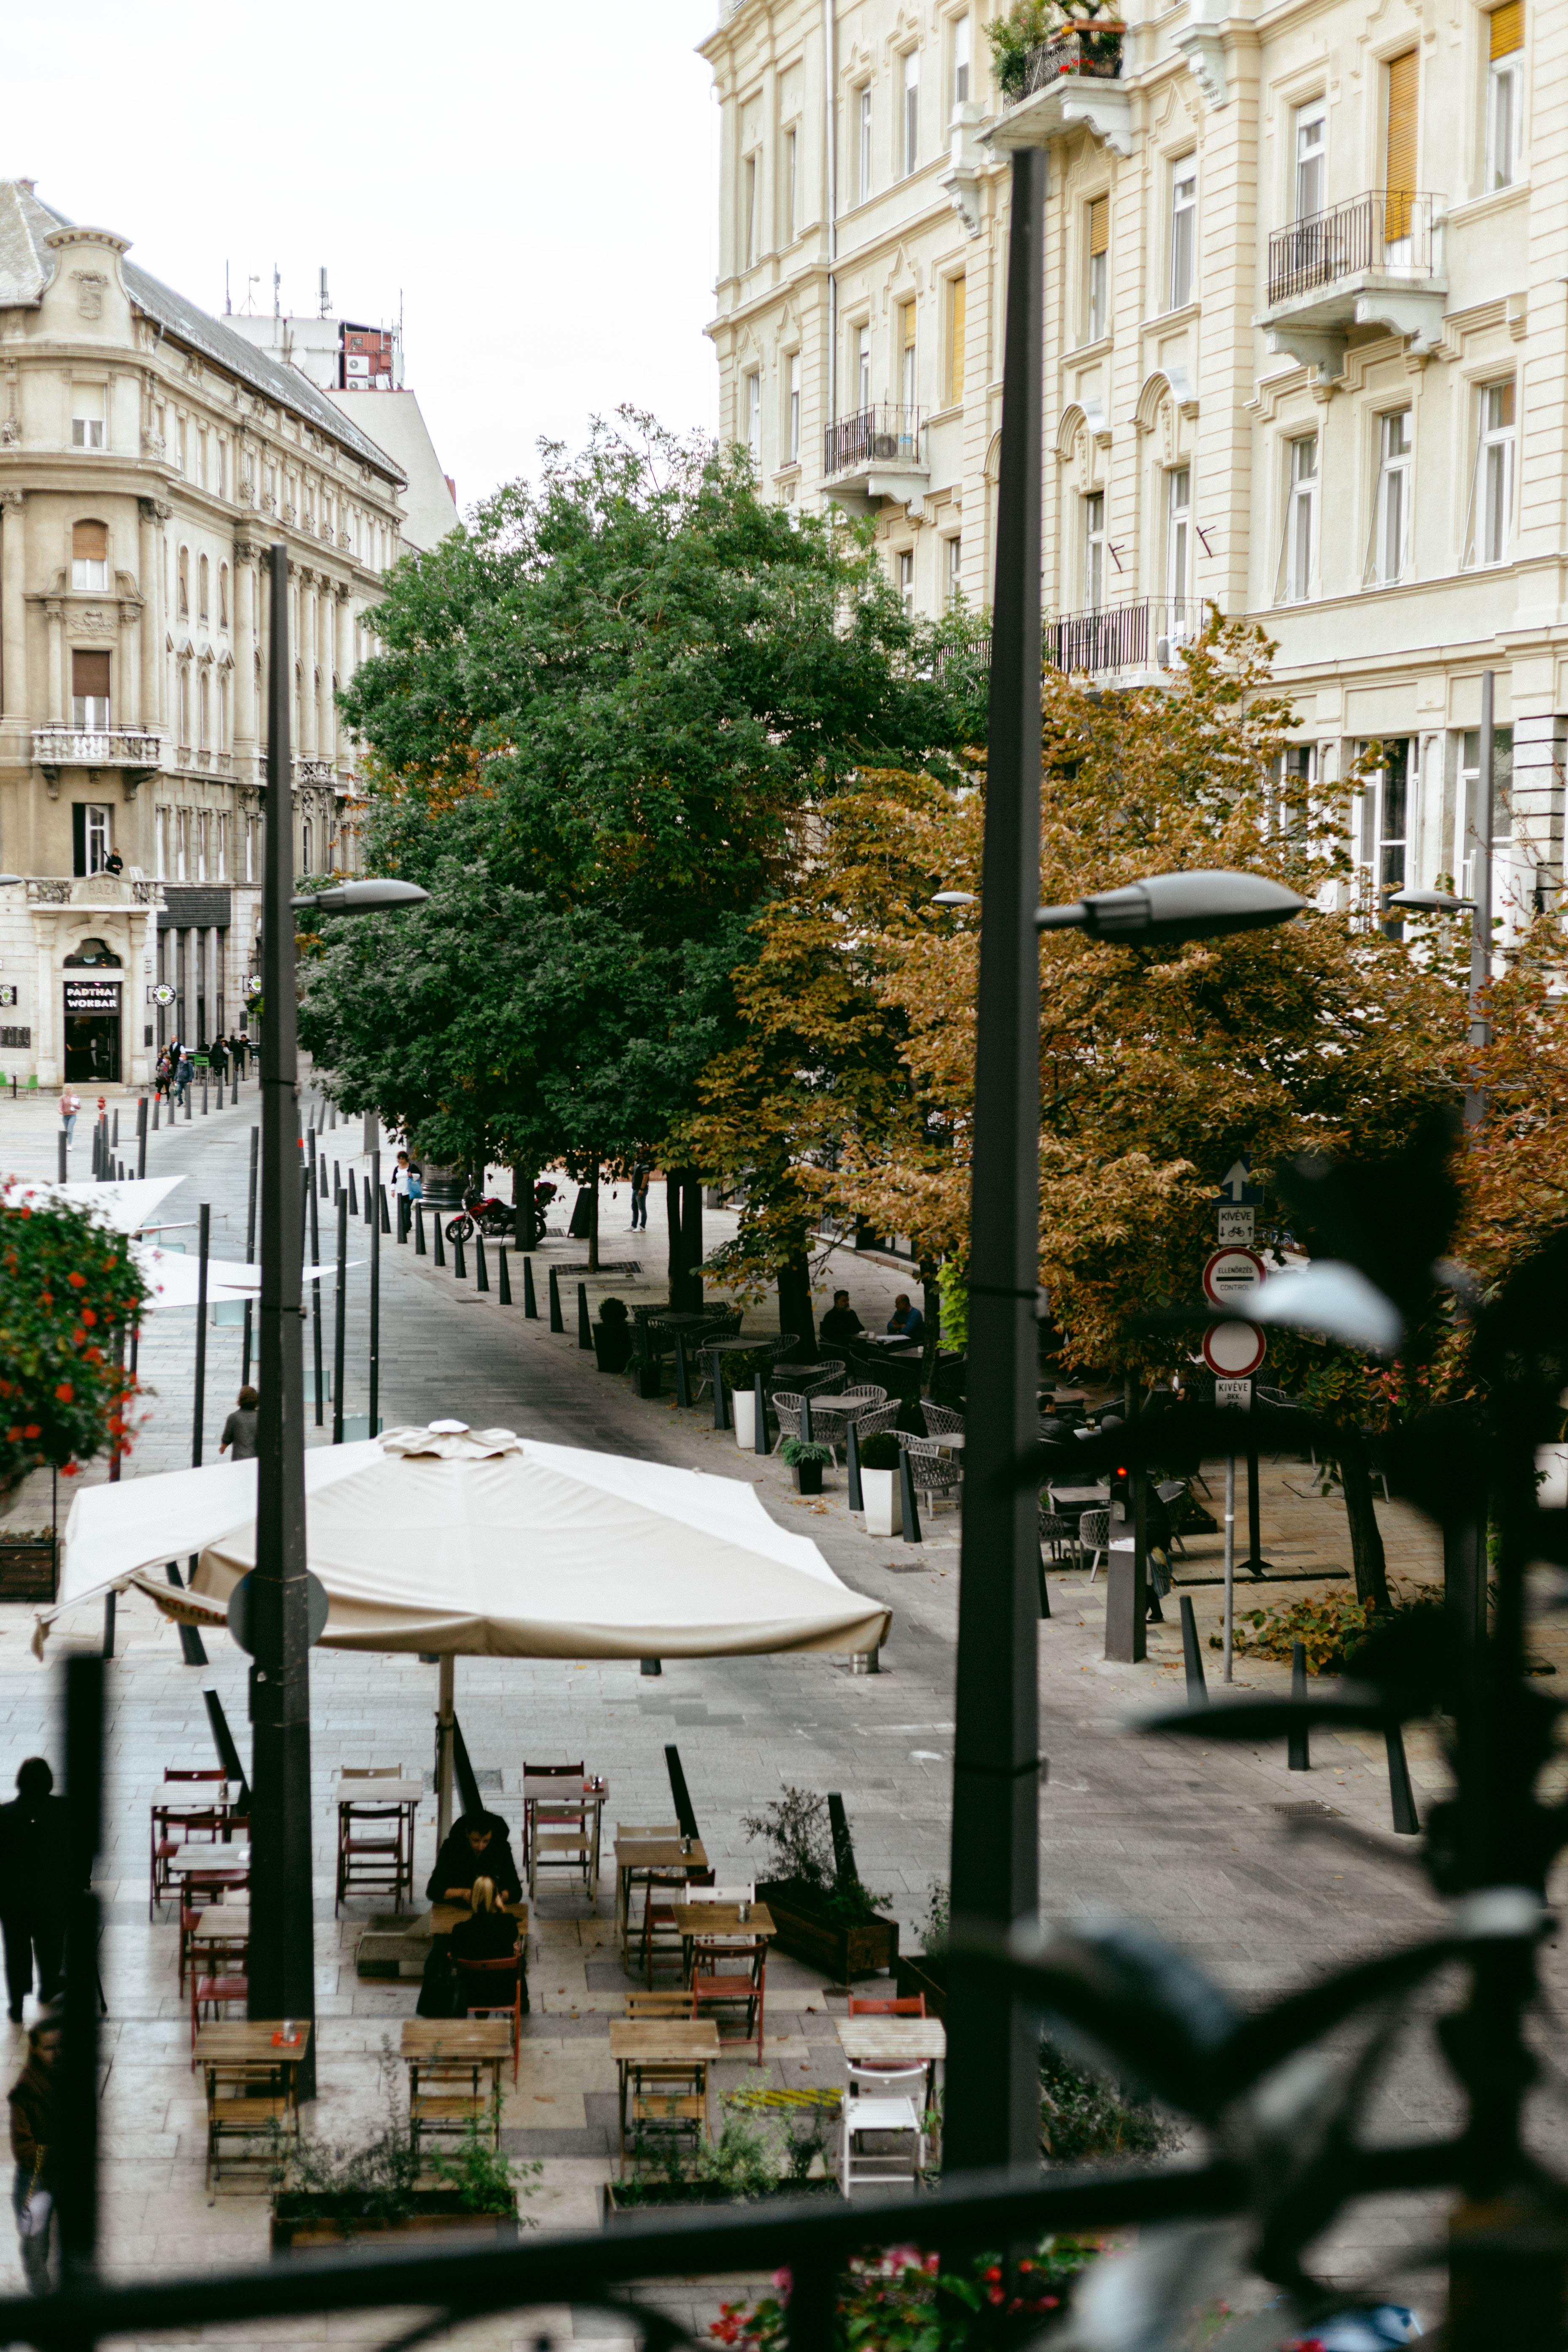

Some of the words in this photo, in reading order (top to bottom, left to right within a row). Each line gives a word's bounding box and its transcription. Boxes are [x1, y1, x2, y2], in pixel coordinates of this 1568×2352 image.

[67, 988, 116, 996] PADTHAI
[68, 1000, 116, 1008] WOKBAR
[1221, 1209, 1251, 1221] KIVÉVE
[1219, 1381, 1248, 1392] KIVÉVE
